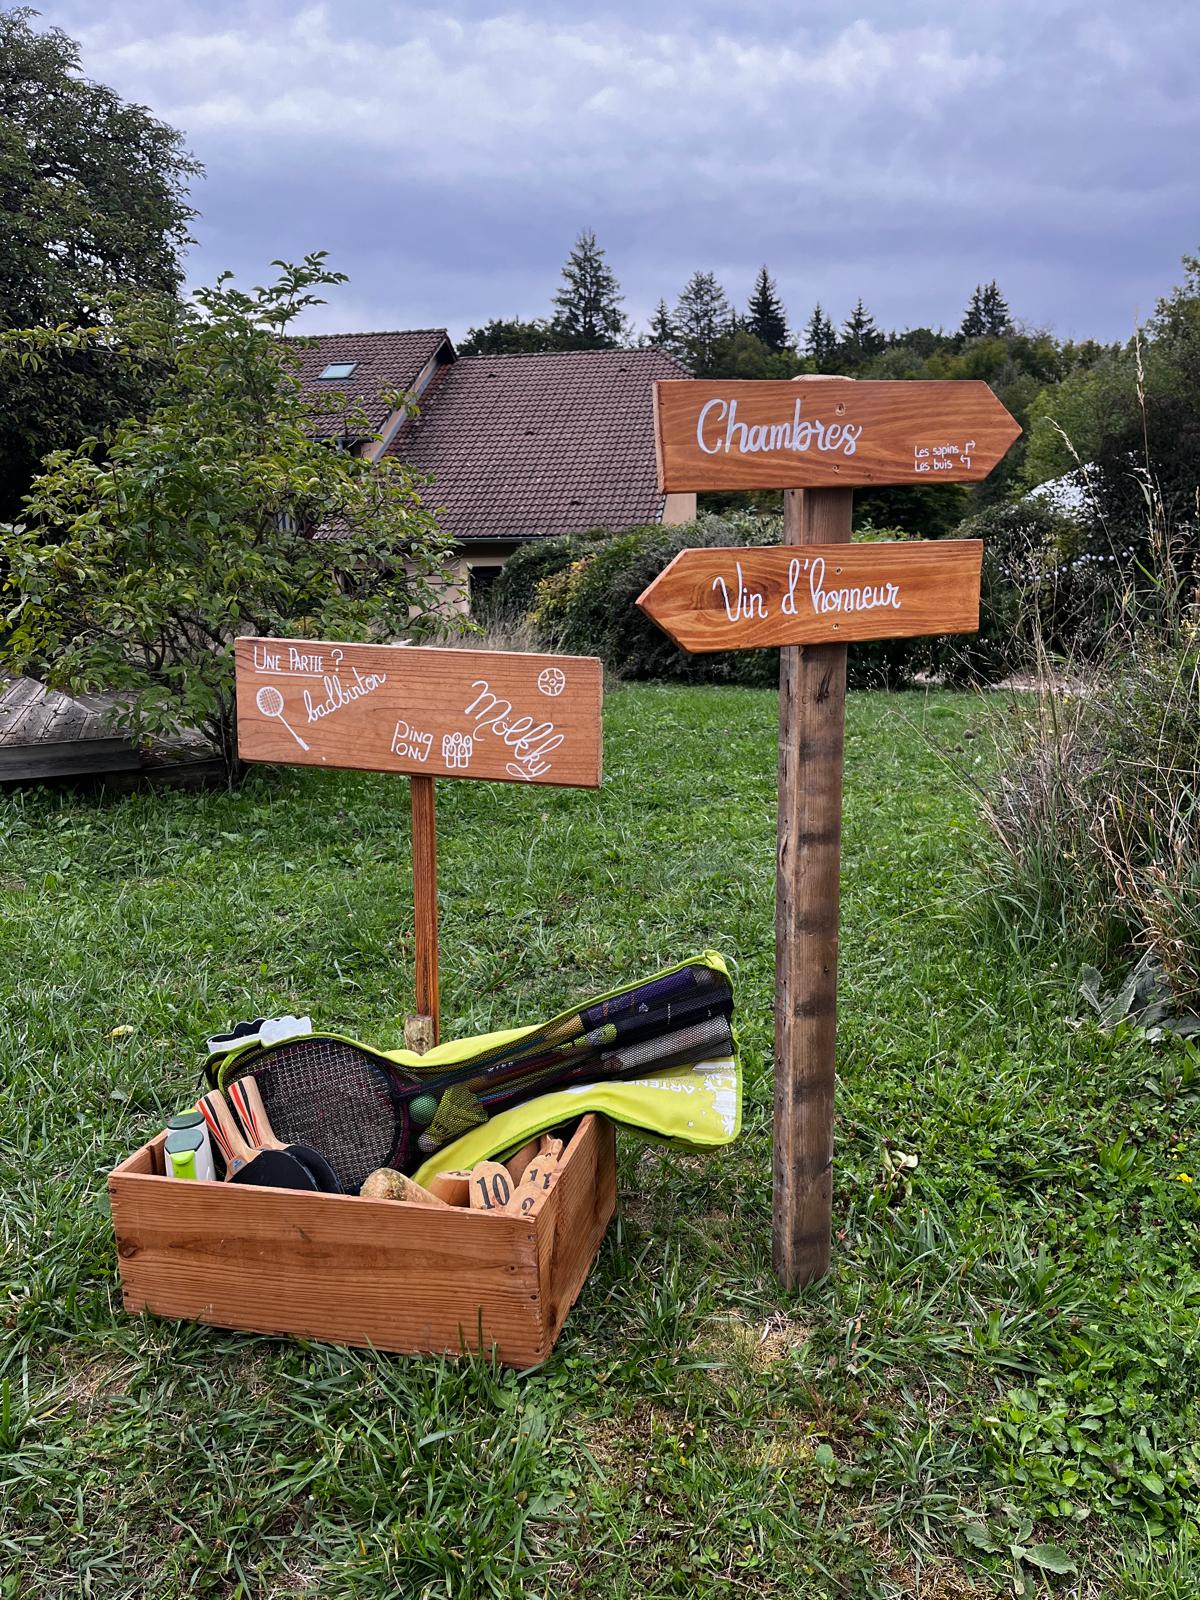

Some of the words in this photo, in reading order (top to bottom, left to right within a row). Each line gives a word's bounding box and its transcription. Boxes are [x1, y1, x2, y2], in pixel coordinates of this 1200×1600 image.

[697, 397, 863, 456] Chambres
[914, 445, 930, 458] Les
[932, 443, 960, 459] sapins
[914, 459, 931, 472] Les
[933, 458, 953, 470] buis
[712, 562, 769, 622] Vin
[781, 557, 902, 615] d'honneur
[476, 1173, 511, 1210] 10
